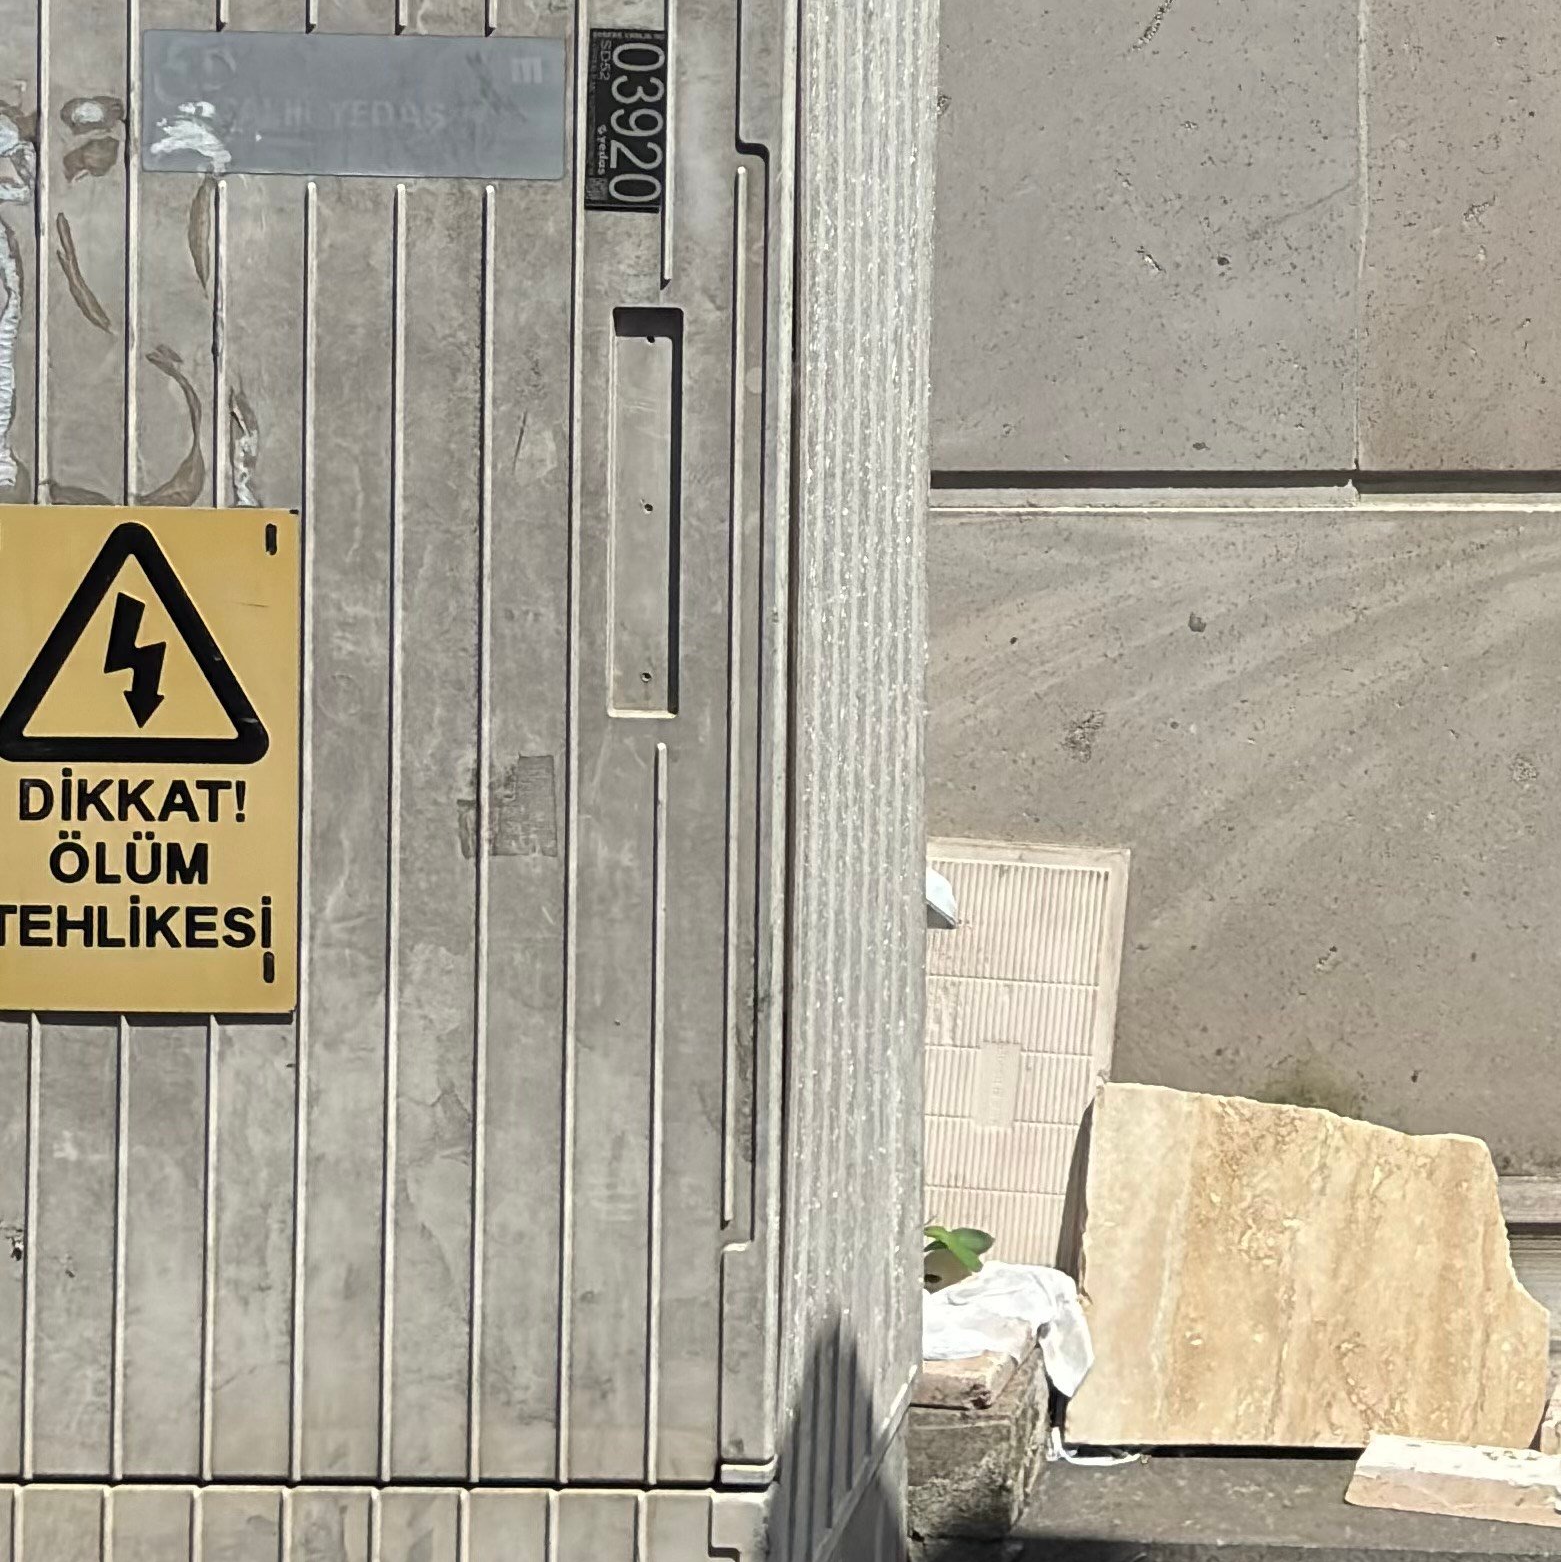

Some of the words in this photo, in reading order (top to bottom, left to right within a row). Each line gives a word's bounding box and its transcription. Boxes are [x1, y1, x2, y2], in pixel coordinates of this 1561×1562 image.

[600, 39, 612, 81] SD52
[608, 42, 666, 203] 03920
[18, 767, 246, 823] DİKKAT!
[49, 830, 208, 886] ÖLÜM
[0, 895, 272, 949] TEHLİKESİ
